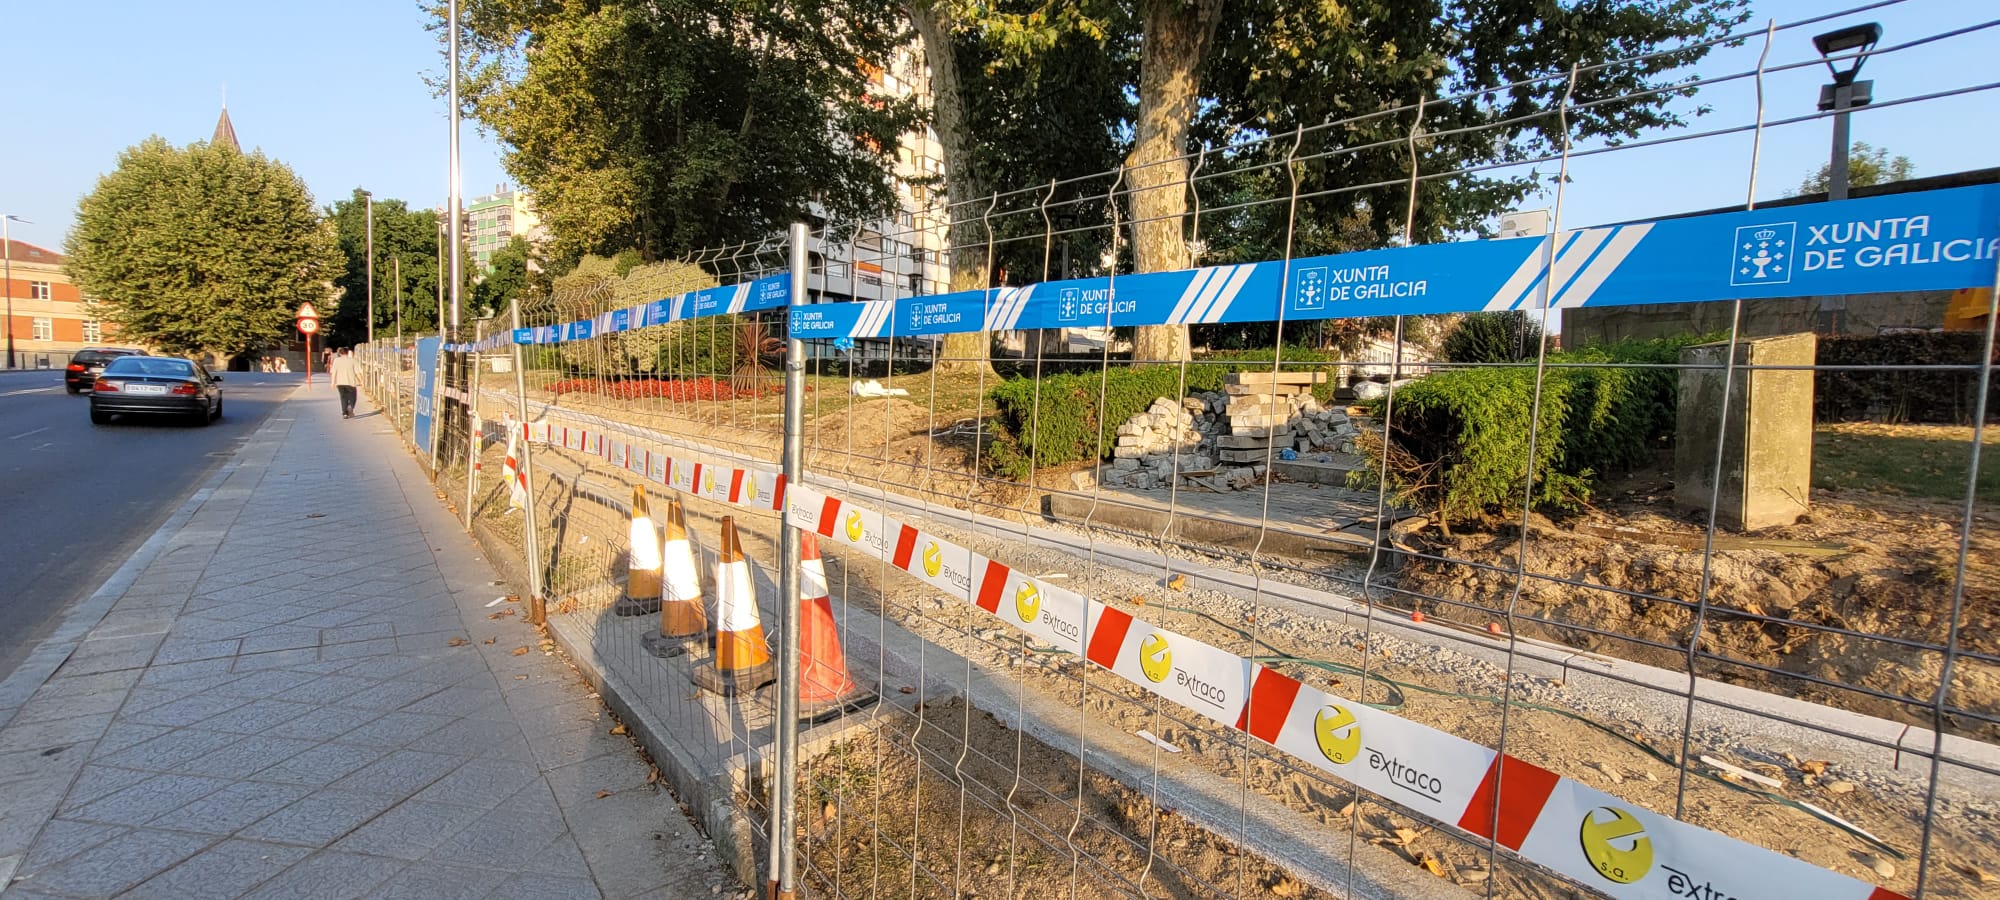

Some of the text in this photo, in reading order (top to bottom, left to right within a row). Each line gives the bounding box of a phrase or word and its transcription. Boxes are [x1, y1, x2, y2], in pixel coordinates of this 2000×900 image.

[1806, 215, 1930, 246] XUNTA
[1803, 248, 1847, 271] DE
[1331, 265, 1390, 284] XUNTA
[1329, 280, 1427, 301] DE GALICIA
[802, 311, 823, 321] XUNTA
[923, 303, 947, 314] XUNTA
[923, 312, 961, 324] DE GALICIA
[1079, 303, 1093, 315] DE
[802, 320, 834, 330] DE GALICIA
[864, 532, 889, 550] extrao
[1042, 611, 1079, 639] extraco
[1176, 669, 1226, 705] extraco
[1368, 750, 1442, 797] extraco
[1600, 861, 1630, 881] s.a.
